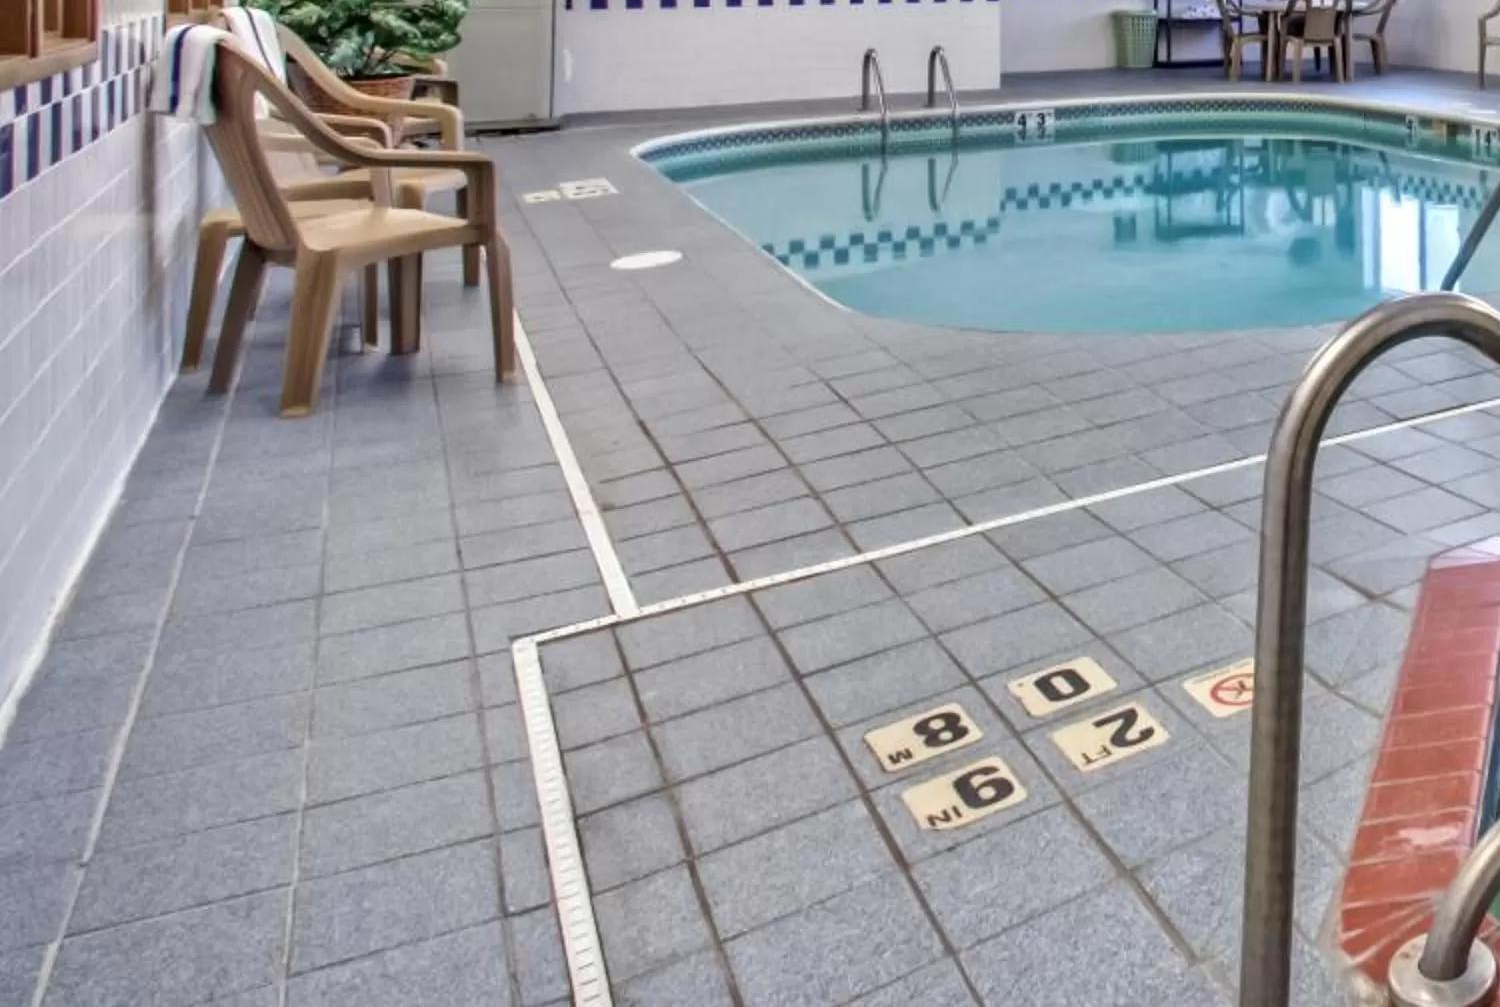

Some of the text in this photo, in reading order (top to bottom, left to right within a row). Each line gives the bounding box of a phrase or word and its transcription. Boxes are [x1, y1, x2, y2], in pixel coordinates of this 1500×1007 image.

[913, 712, 969, 748] 8
[1093, 708, 1155, 748] 2
[887, 748, 914, 766] M
[1082, 744, 1112, 765] FT
[926, 806, 963, 827] IN
